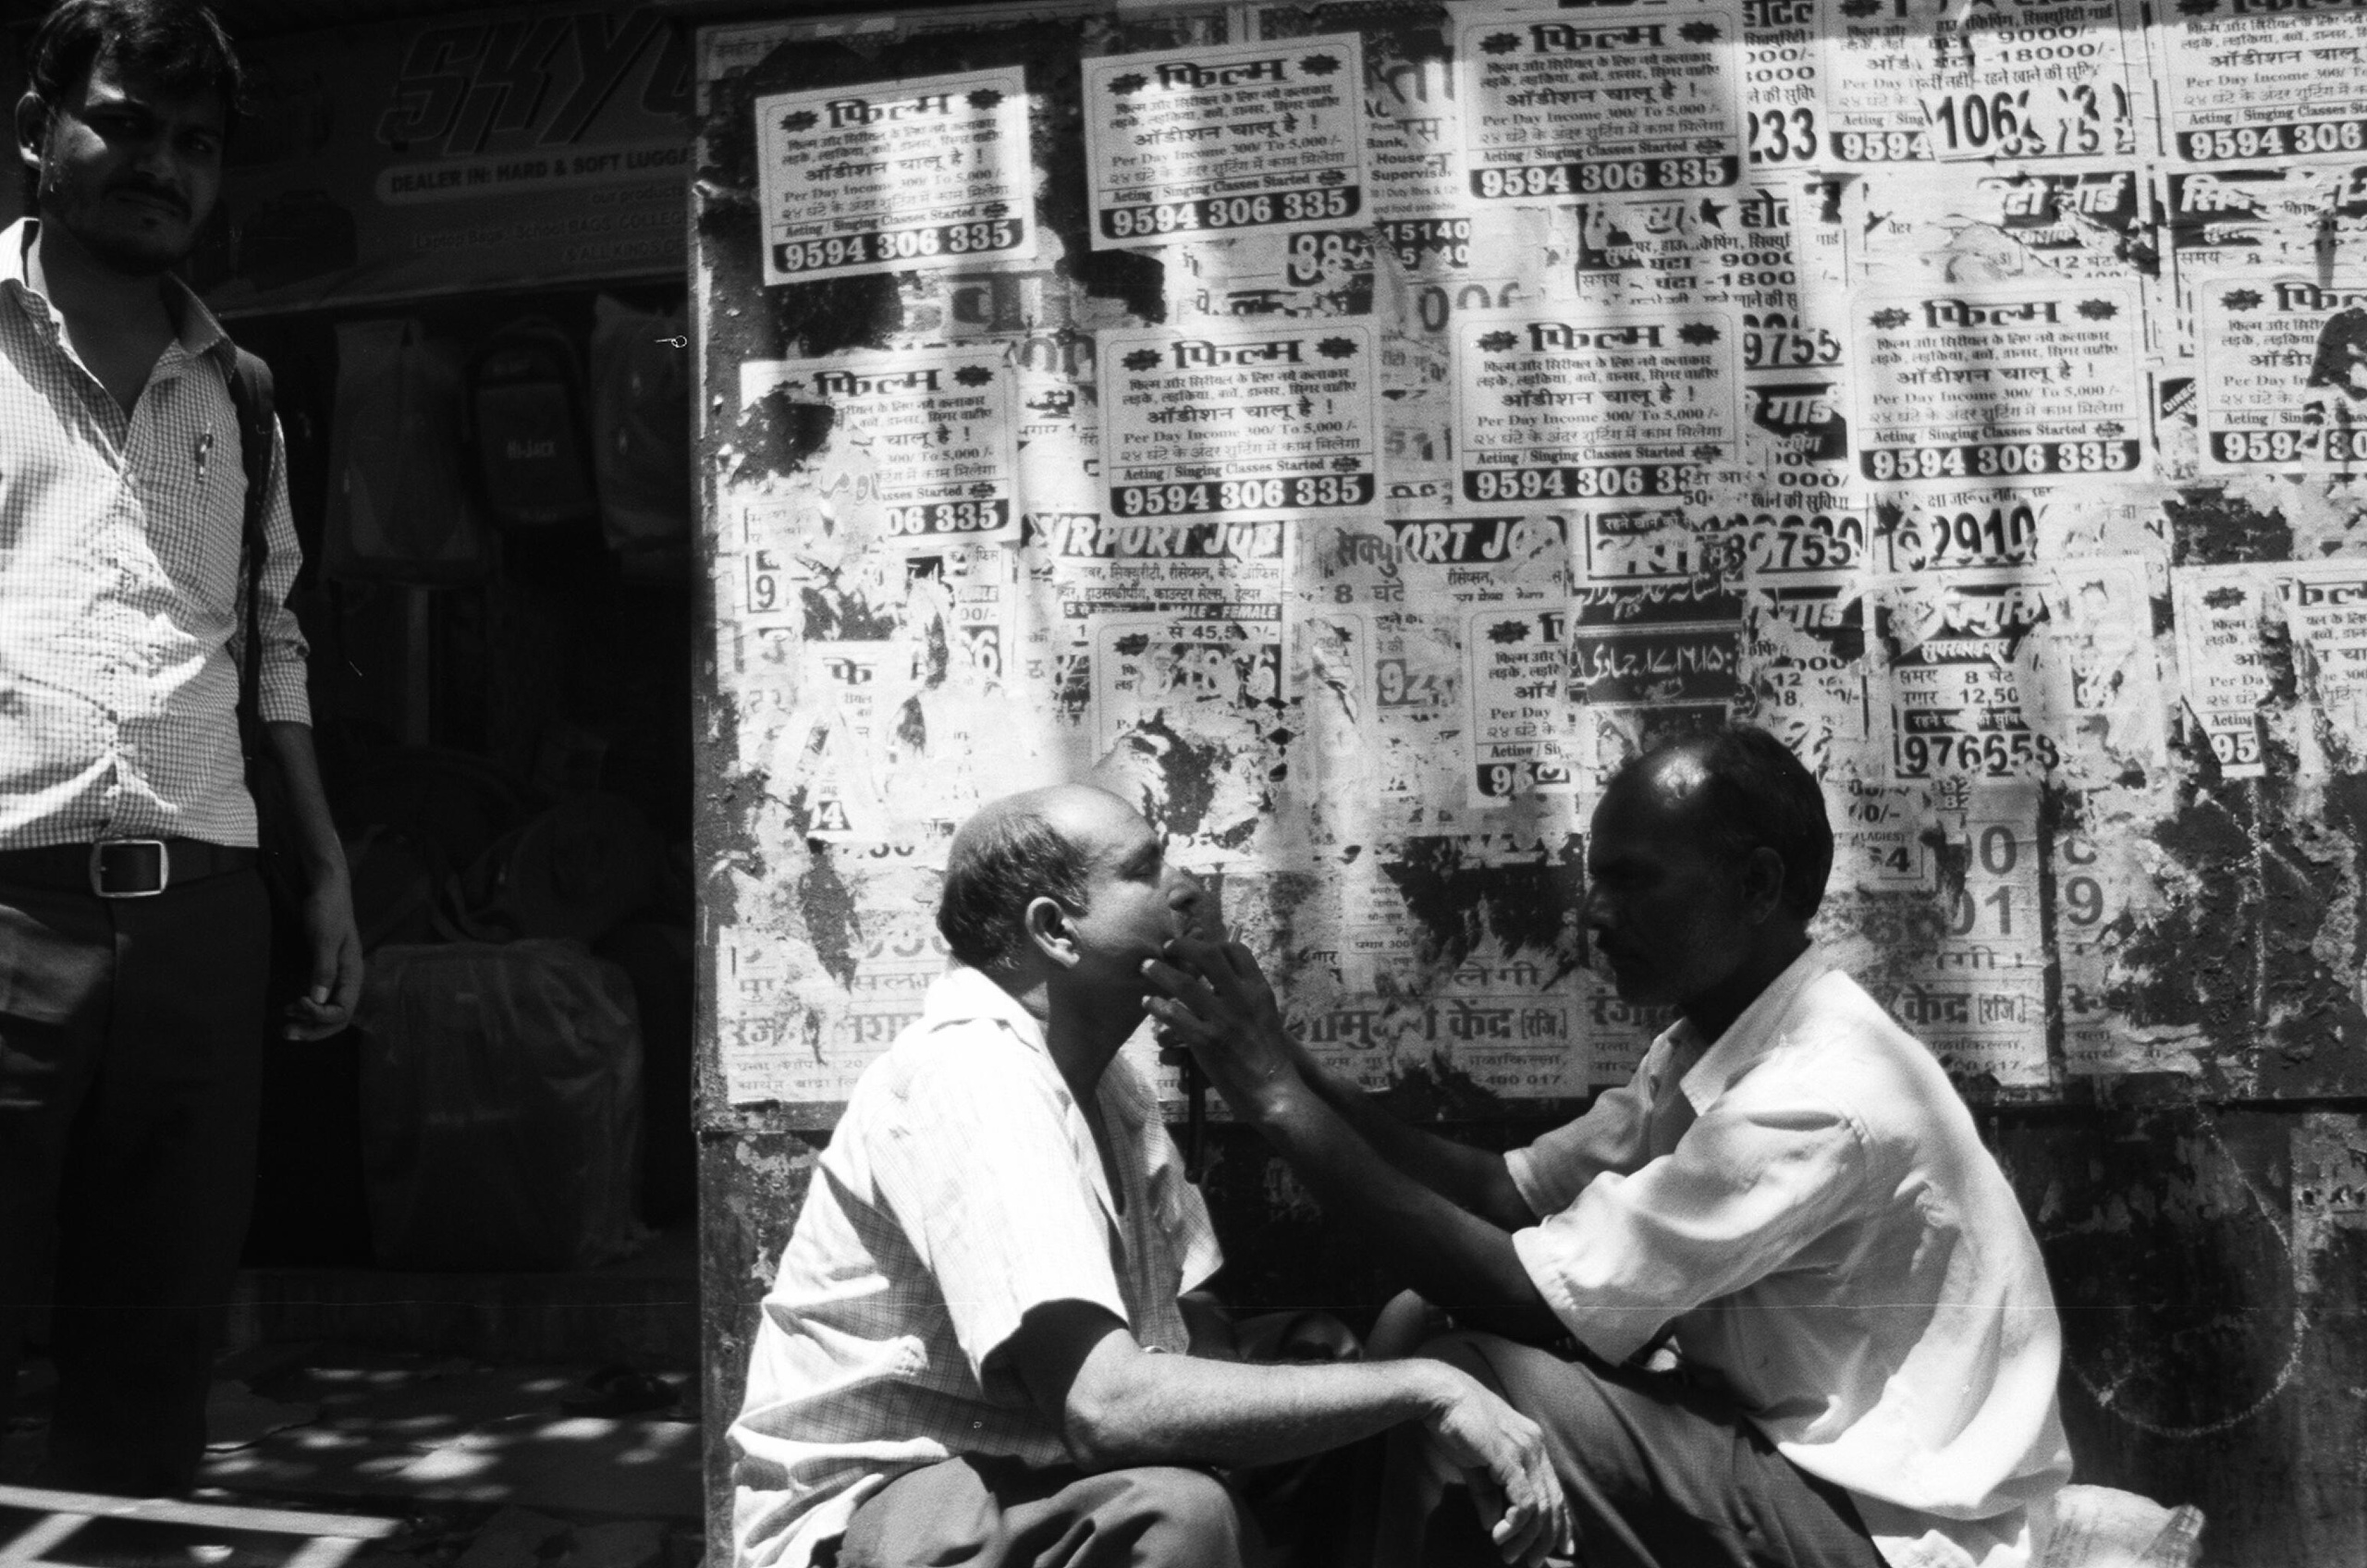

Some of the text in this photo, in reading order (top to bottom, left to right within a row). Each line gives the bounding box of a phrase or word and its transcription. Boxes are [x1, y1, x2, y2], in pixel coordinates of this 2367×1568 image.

[1529, 24, 1666, 52] फिल्म
[1156, 60, 1287, 90] फिल्म
[2186, 76, 2214, 88] Per
[2218, 74, 2248, 86] Day
[827, 94, 953, 127] फिल्म
[2189, 105, 2345, 126] Acting Singing Classes
[2189, 122, 2362, 160] 9594 306
[391, 168, 461, 192] DEALER
[497, 160, 548, 182] HARD
[554, 158, 567, 177] &
[573, 153, 620, 176] SOFT
[1481, 158, 1725, 196] 9594 306 335
[1112, 205, 1198, 235] 9594
[1208, 196, 1272, 225] 306
[1283, 190, 1348, 216] 335
[785, 222, 1012, 268] 9594 306 335
[1920, 300, 2063, 328] फिल्म
[1527, 325, 1665, 350] फिल्म
[1171, 339, 1304, 369] फिल्म
[2225, 412, 2268, 426] Acting
[1873, 442, 2127, 479] 9594 306 335
[917, 486, 963, 497] Started
[1123, 476, 1361, 515] 9594 306 335
[1476, 466, 1644, 499] 9594 306
[936, 501, 1000, 533] 335
[1221, 605, 1277, 619] FEMALE
[1490, 707, 1551, 720] Per Day
[1490, 745, 1533, 759] Acting
